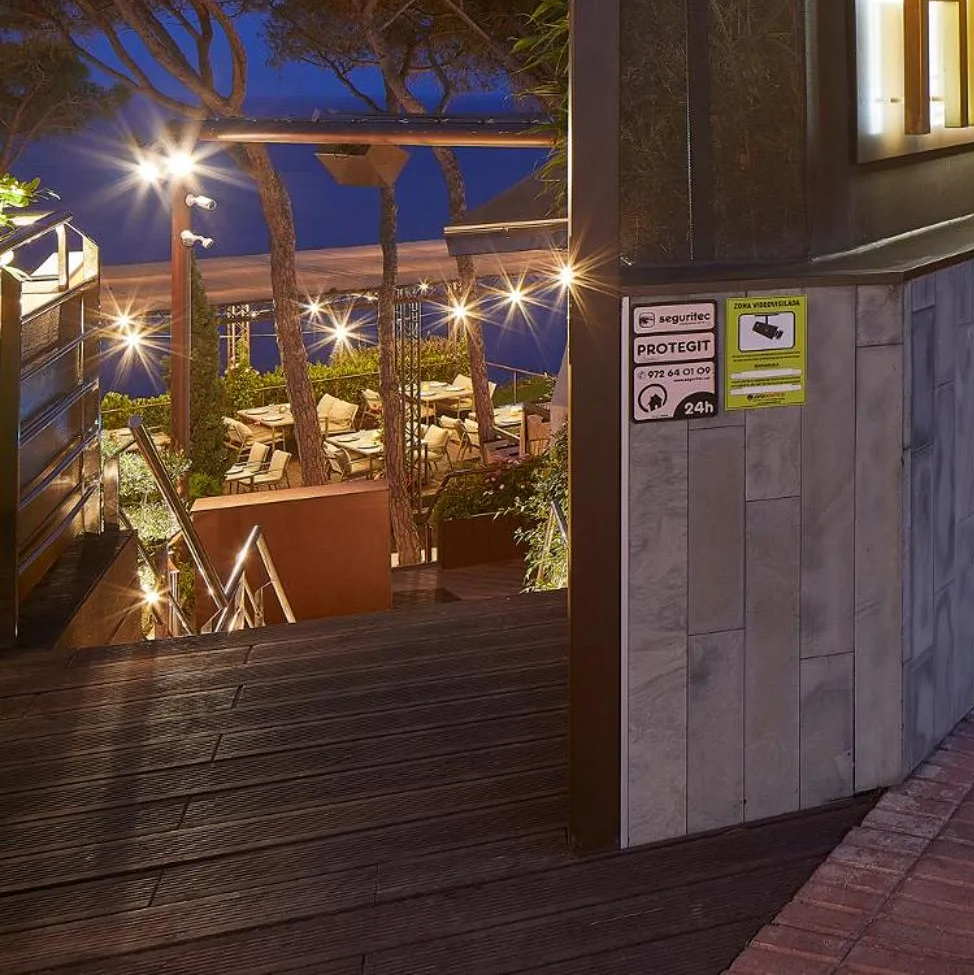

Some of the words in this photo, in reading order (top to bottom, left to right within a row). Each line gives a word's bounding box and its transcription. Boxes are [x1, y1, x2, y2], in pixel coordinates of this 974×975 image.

[659, 312, 711, 324] seguritec
[637, 340, 711, 356] PROTEGIT
[648, 370, 665, 378] 972
[667, 369, 680, 377] 64
[683, 368, 694, 376] 01
[696, 366, 711, 374] 09
[684, 401, 714, 415] 24h
